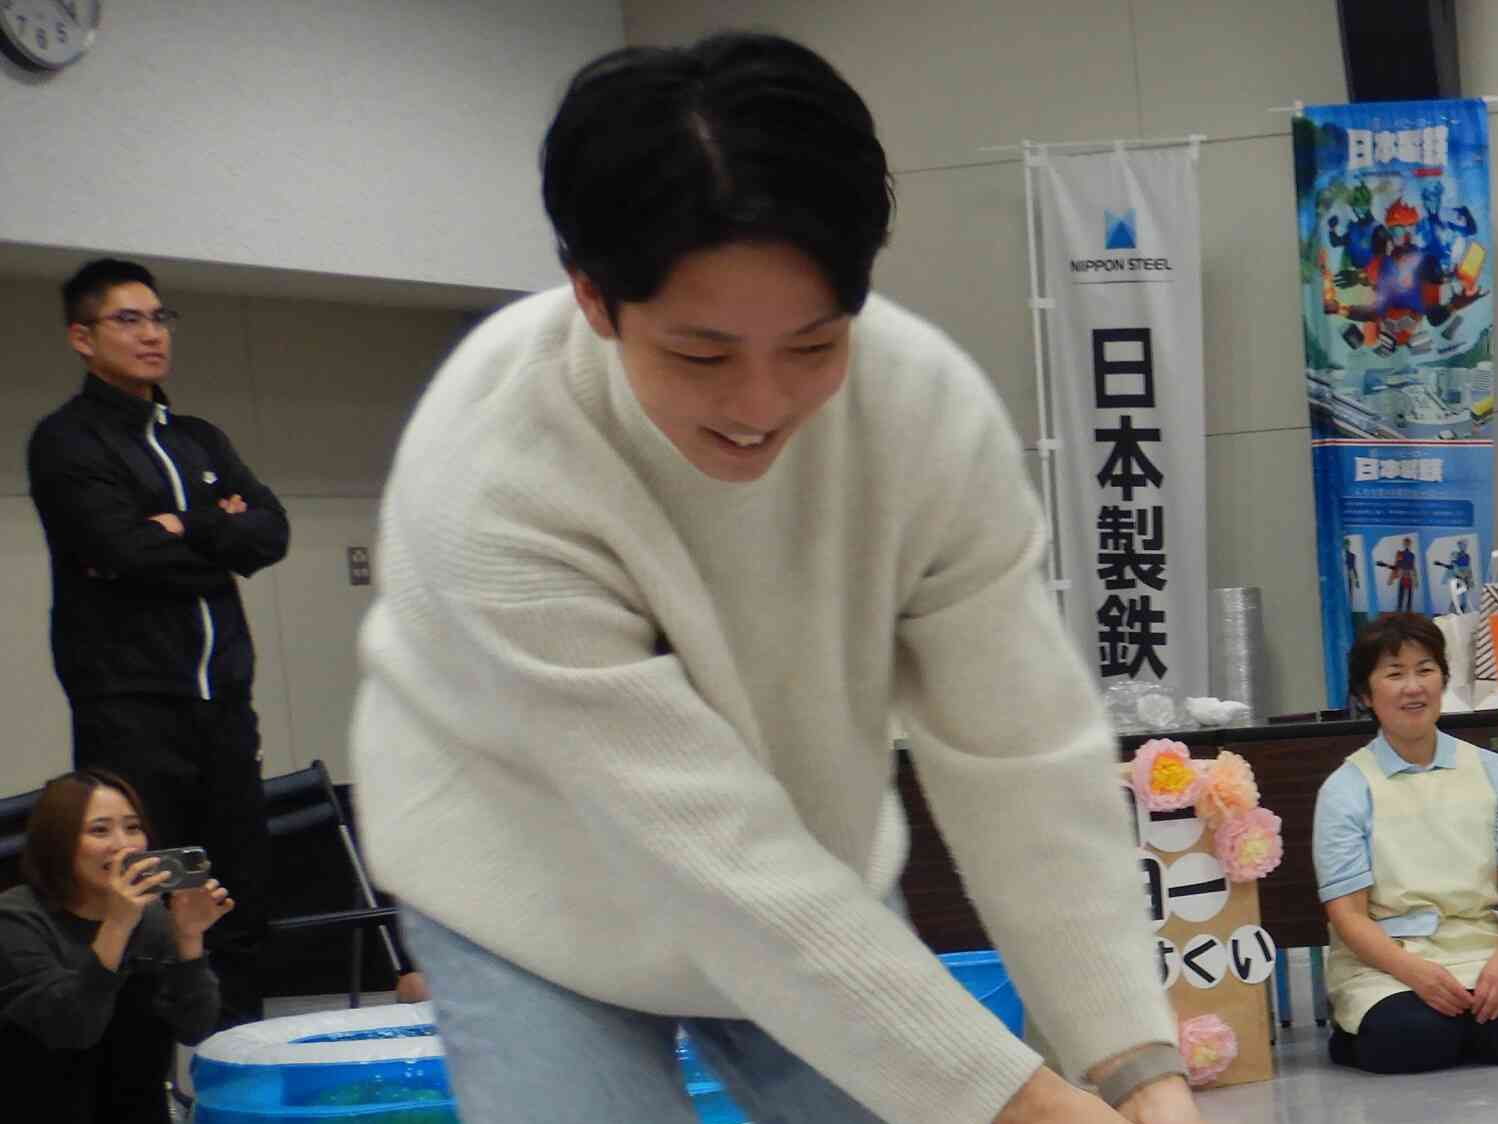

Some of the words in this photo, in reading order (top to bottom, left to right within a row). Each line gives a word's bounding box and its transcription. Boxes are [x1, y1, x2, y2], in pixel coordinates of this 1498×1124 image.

[1070, 258, 1125, 272] NIPPON
[1127, 257, 1173, 271] STEEL
[1092, 327, 1167, 680] 日本製鉄
